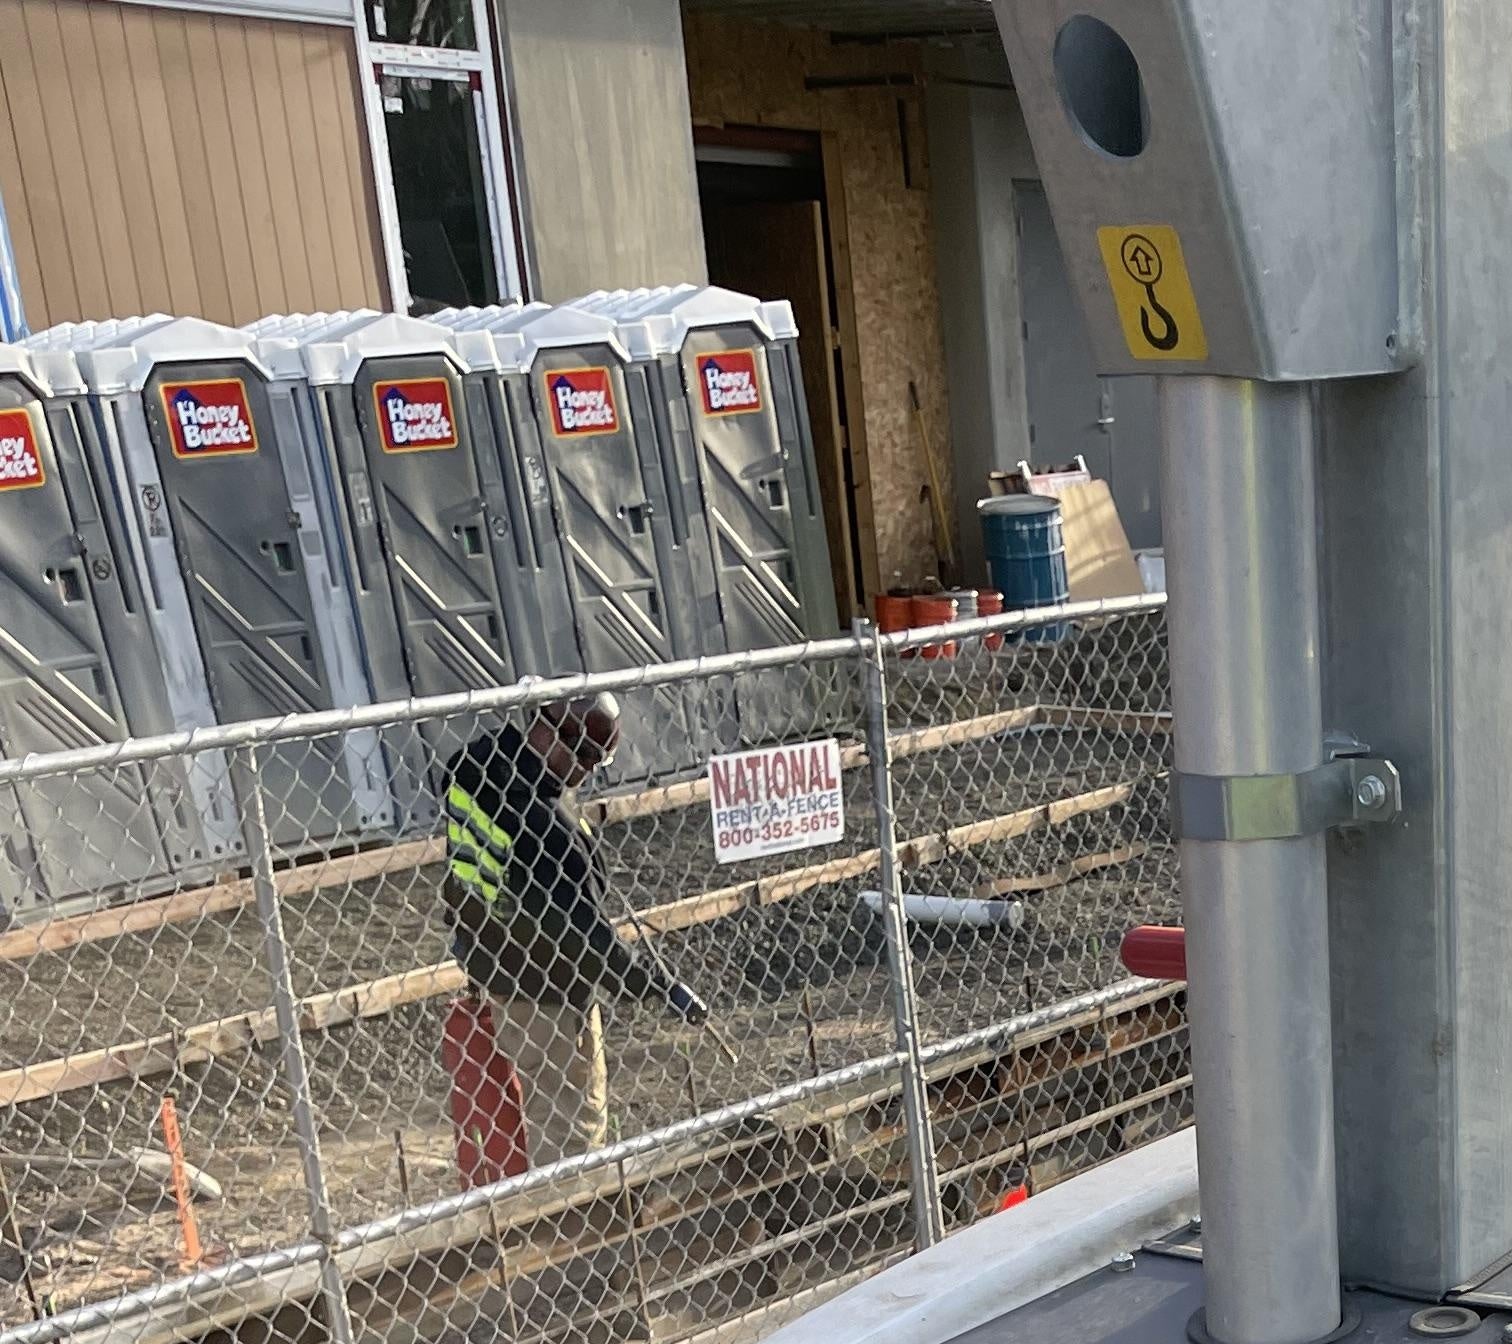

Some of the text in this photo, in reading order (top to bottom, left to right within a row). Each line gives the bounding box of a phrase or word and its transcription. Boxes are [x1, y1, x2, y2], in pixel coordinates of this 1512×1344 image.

[705, 368, 750, 391] Honey
[556, 386, 605, 408] Honey
[710, 384, 757, 408] Bucket
[176, 399, 239, 426] Honey
[387, 398, 442, 422] Honey
[561, 404, 614, 428] Bucket
[183, 420, 251, 448] Bucket
[392, 418, 453, 443] Bucket
[711, 745, 837, 808] NATIONAL
[719, 811, 839, 848] 800-352-5675
